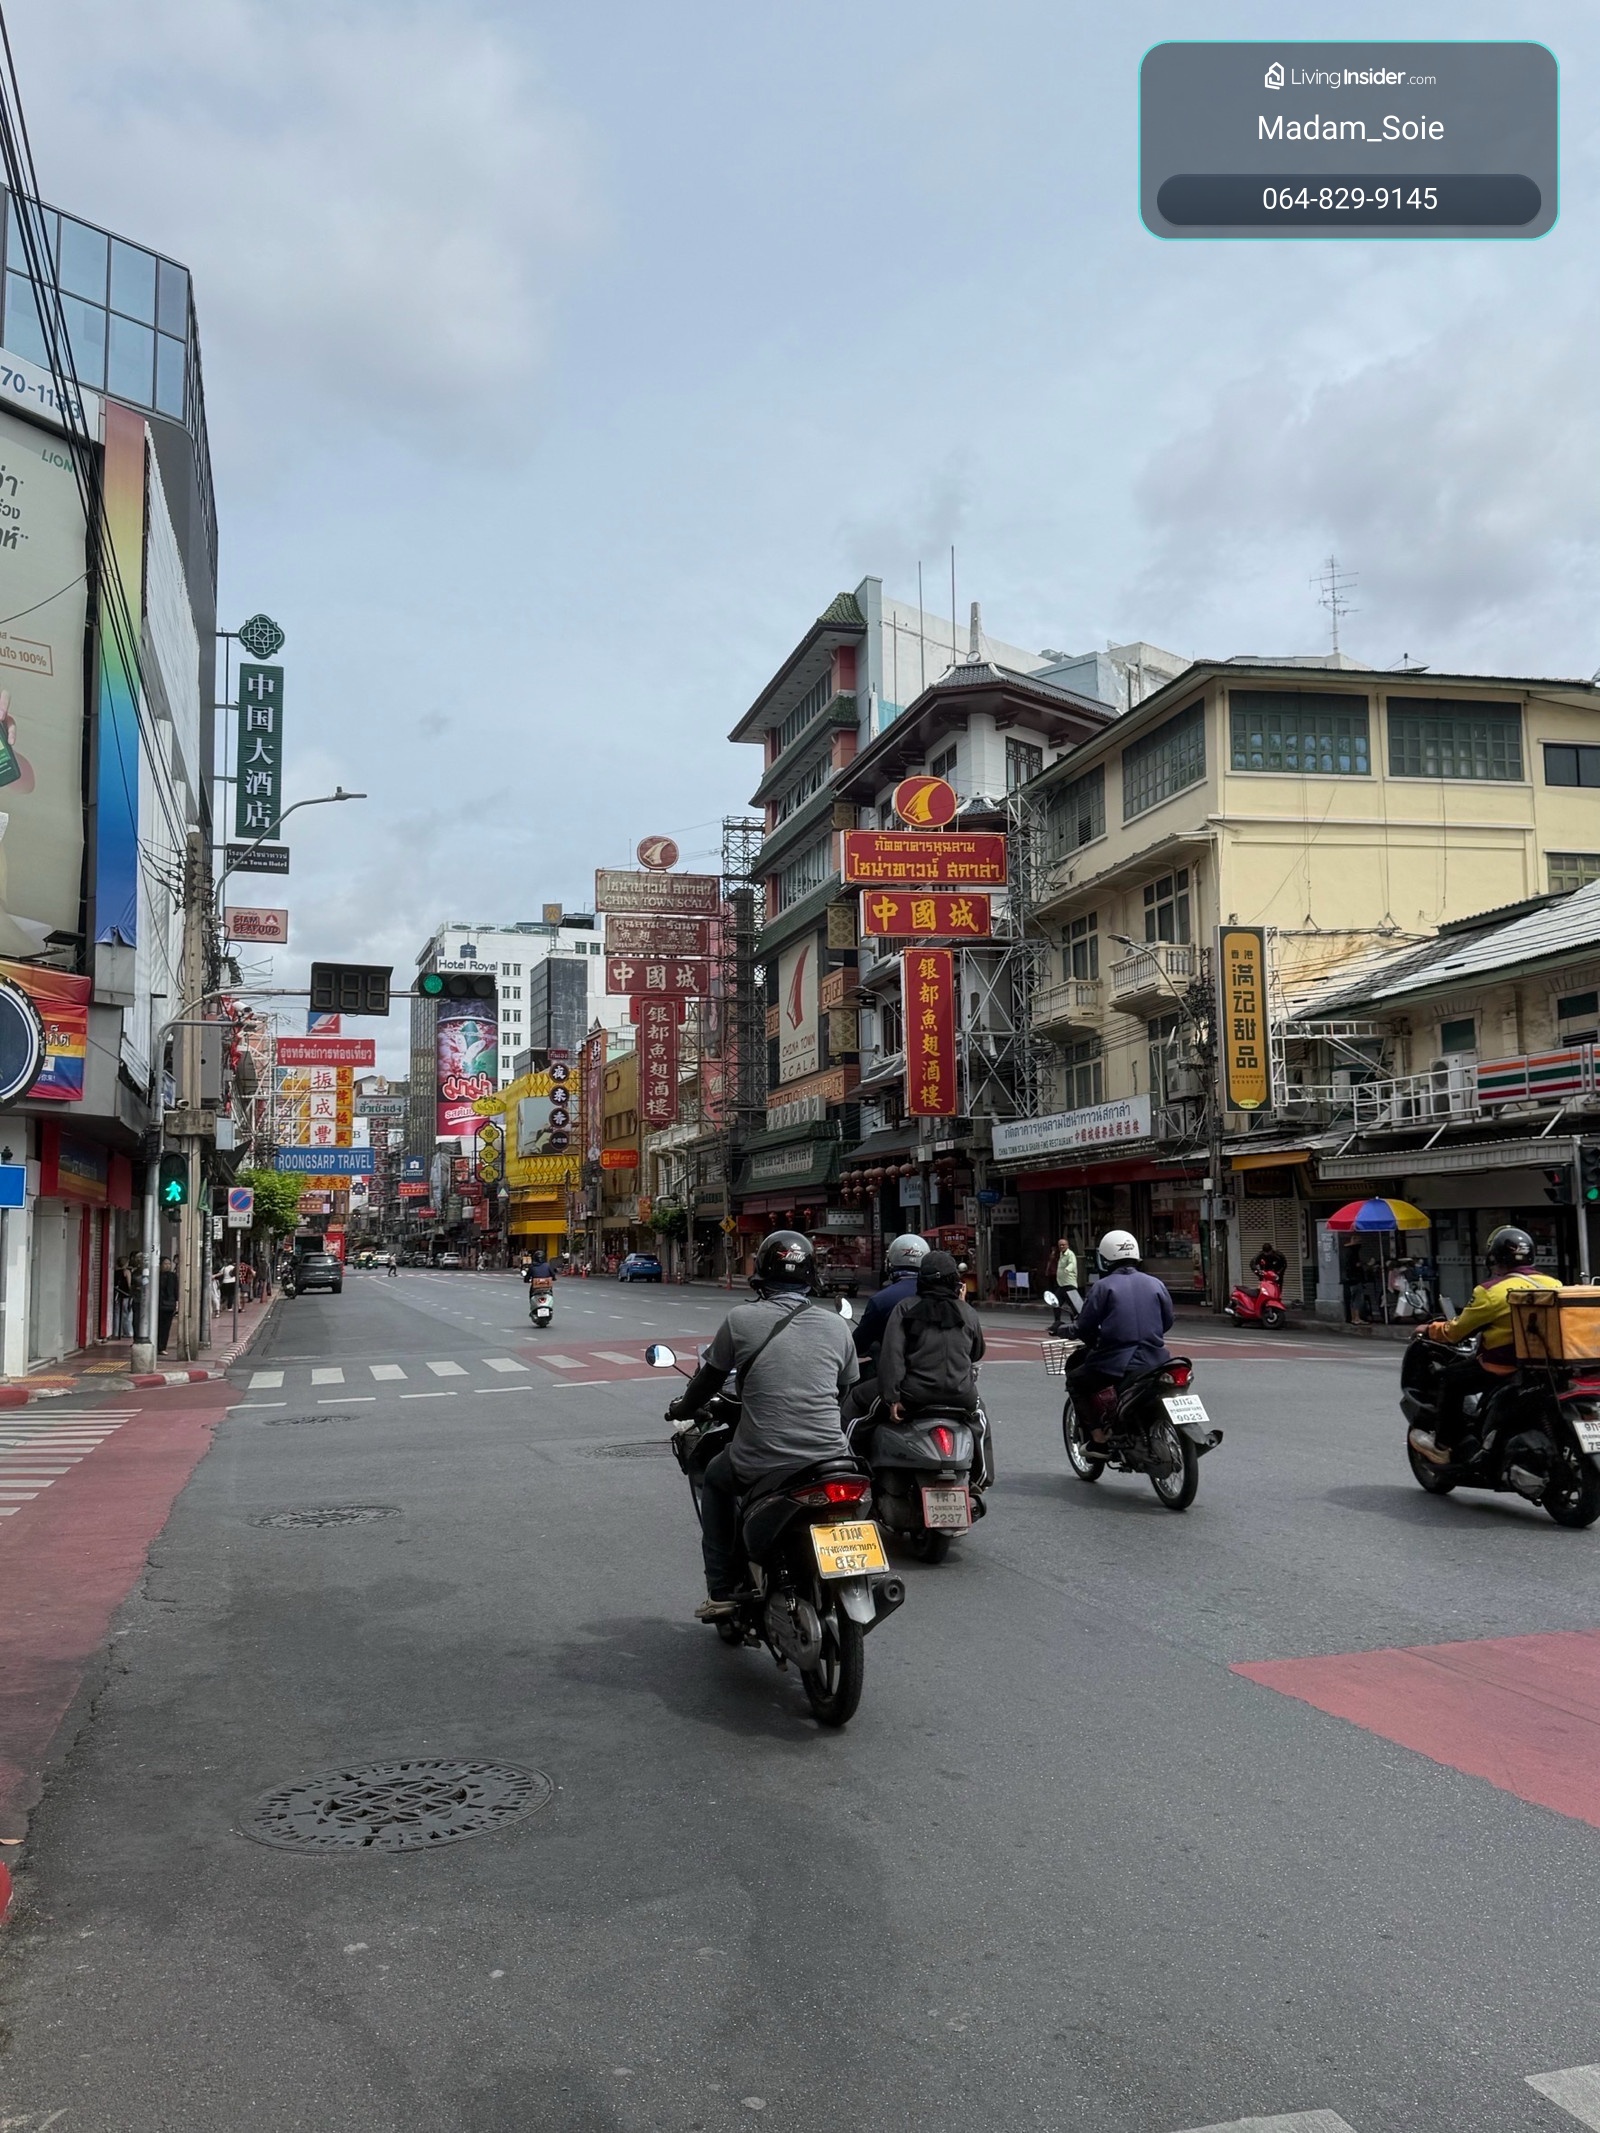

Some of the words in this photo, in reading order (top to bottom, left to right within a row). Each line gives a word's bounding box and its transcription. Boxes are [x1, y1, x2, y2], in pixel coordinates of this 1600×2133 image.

[42, 448, 74, 473] LION
[19, 650, 48, 667] 100%
[244, 673, 275, 829] 中国大酒店
[851, 852, 939, 878] ไชน่าทาวน์
[947, 857, 1001, 879] สกาล่า
[604, 894, 639, 906] CHINA
[642, 896, 675, 907] TOWN
[677, 898, 713, 909] SCALA
[872, 895, 979, 932] 中國城
[438, 959, 466, 970] Hotel
[469, 961, 498, 972] Royal
[613, 961, 700, 993] 中國城
[918, 957, 943, 1109] 銀都魚翅酒樓
[646, 1006, 672, 1116] 銀都魚翅酒樓
[782, 1057, 816, 1080] SCALA
[278, 1154, 335, 1169] ROONGSARP
[338, 1154, 372, 1169] TRAVEL
[932, 1513, 962, 1524] 2237
